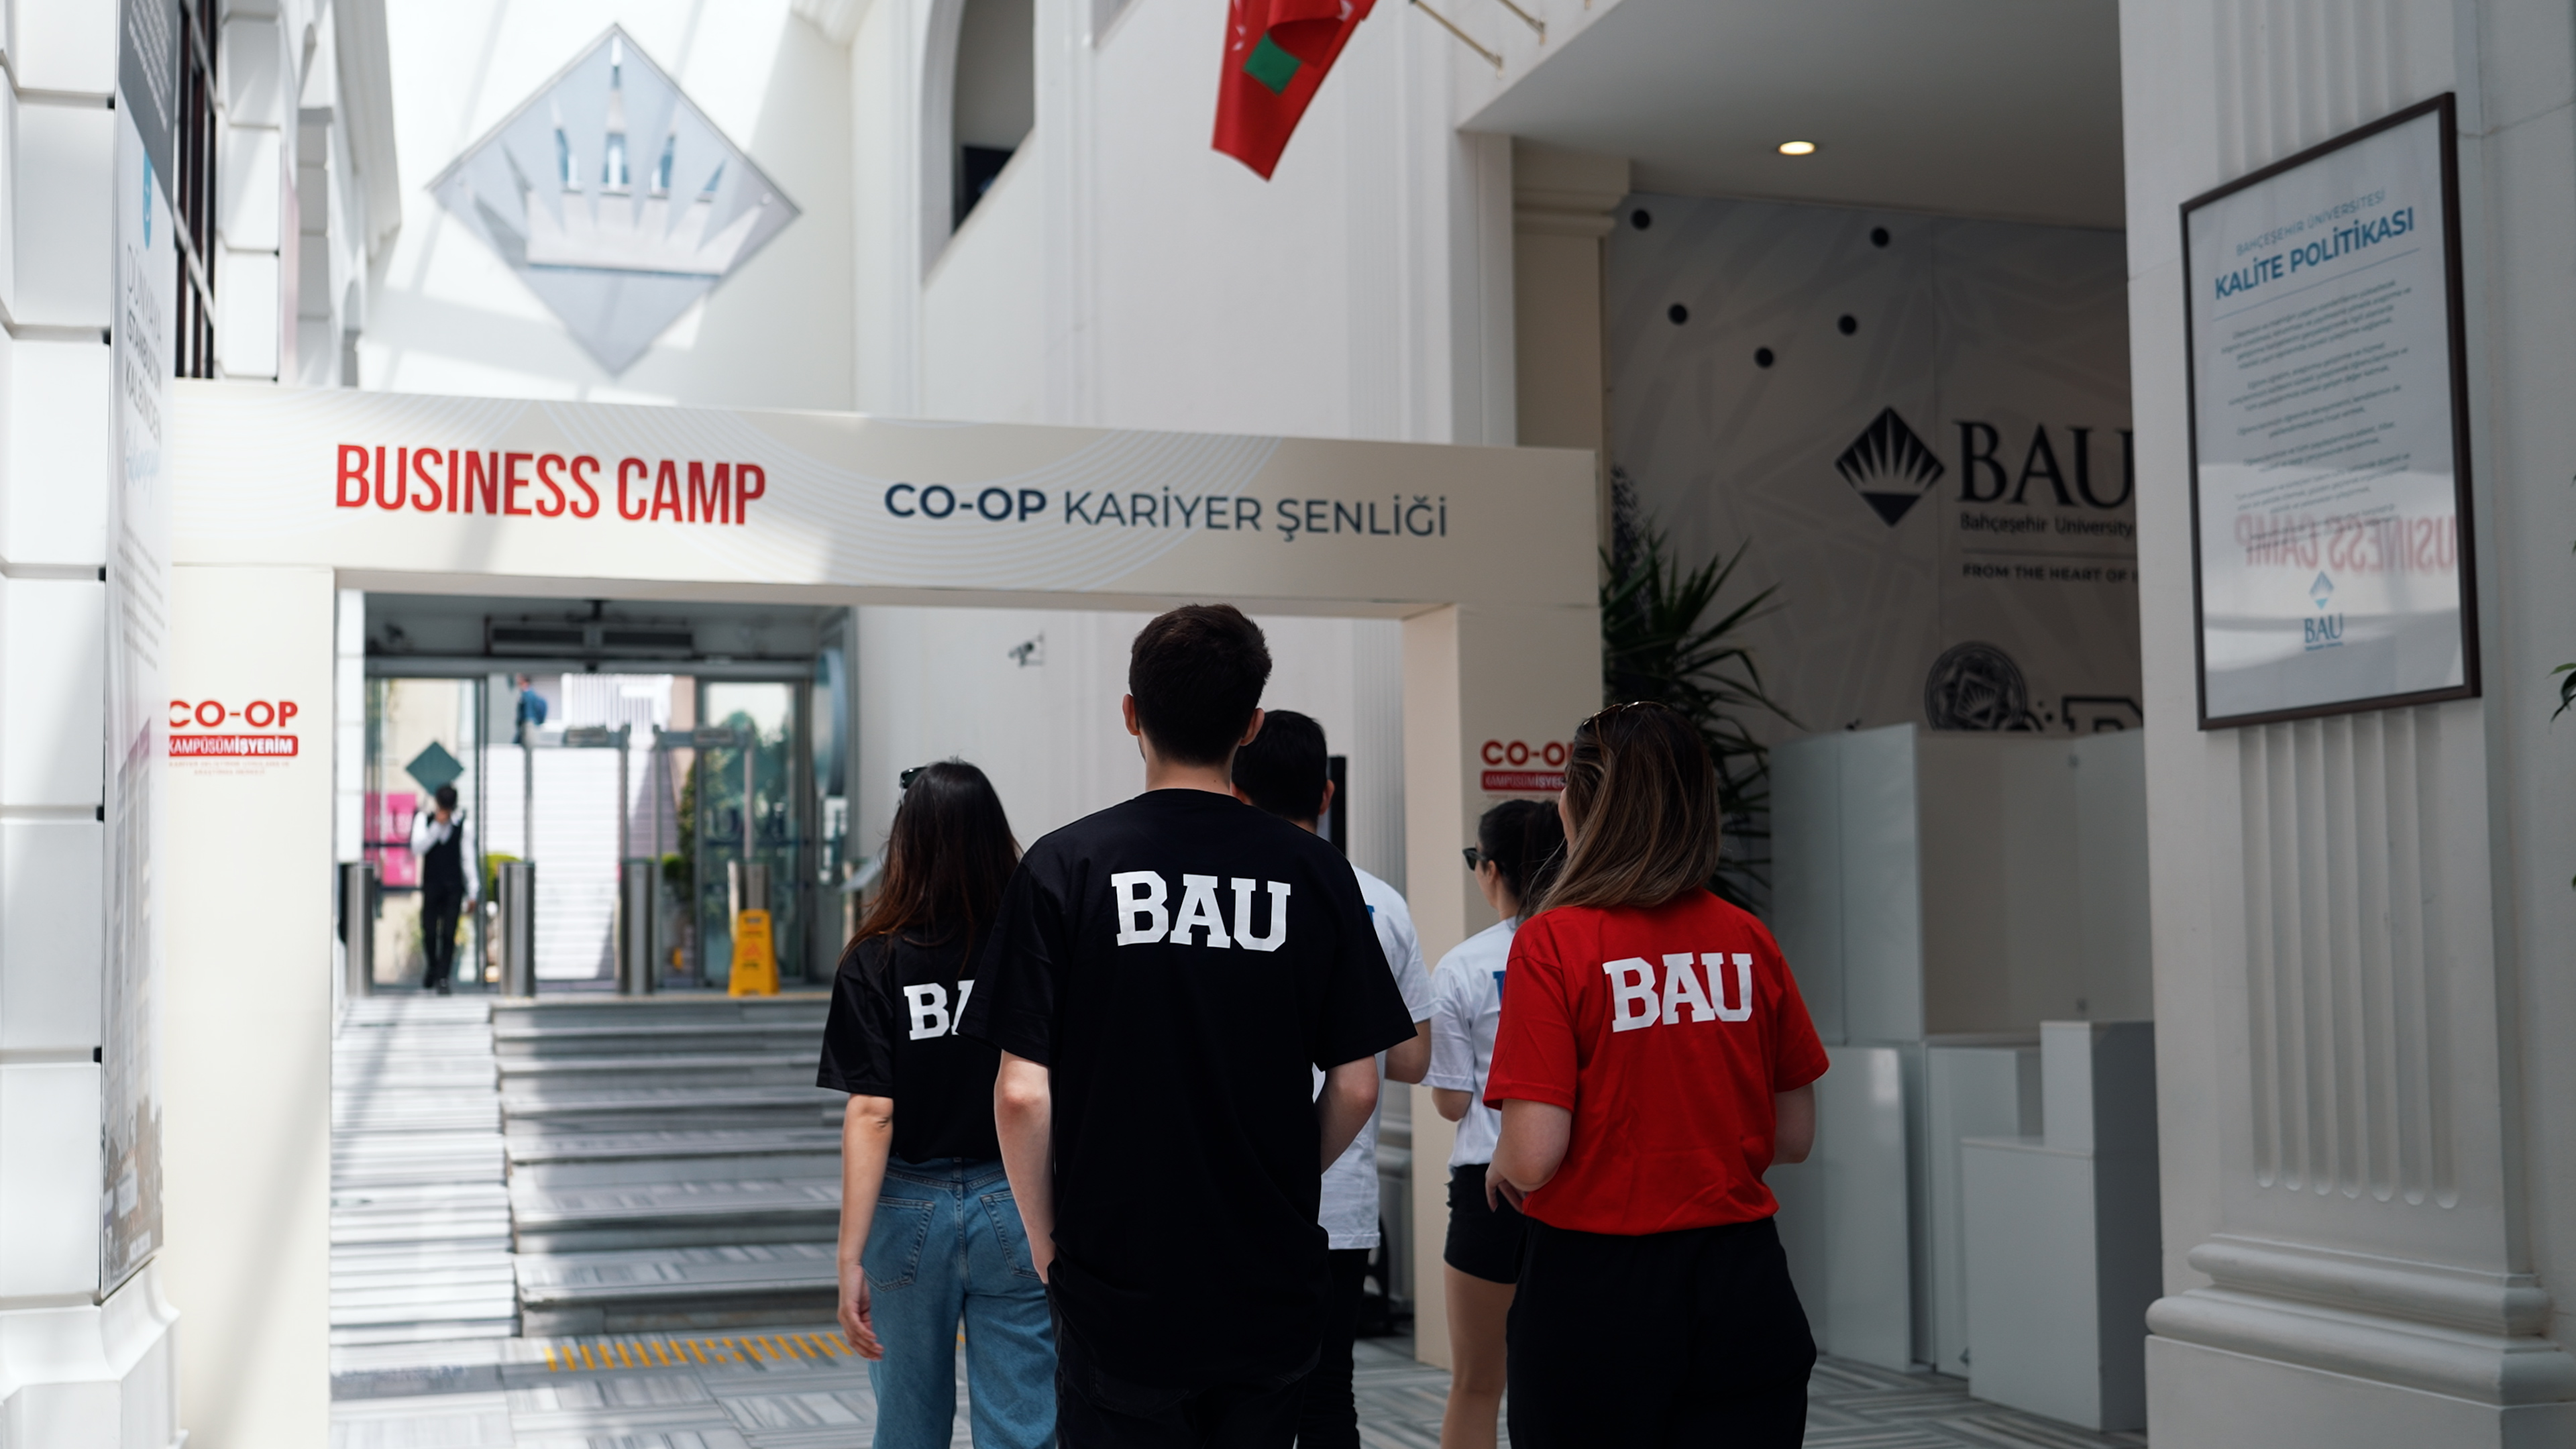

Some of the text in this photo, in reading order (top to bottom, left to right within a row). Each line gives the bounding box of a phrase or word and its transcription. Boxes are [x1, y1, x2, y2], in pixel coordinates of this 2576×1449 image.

[2215, 205, 2414, 300] KALİTE POLİTİKASI
[335, 443, 767, 526] BUSINESS CAMP
[1951, 419, 2133, 510] BAU
[884, 483, 1448, 542] CO-OP KARİYER ŞENLİĞİ
[1960, 513, 2135, 541] Bahçeşehir University
[1962, 563, 2009, 578] FROM
[2014, 565, 2045, 580] THE
[2049, 566, 2102, 582] HEART
[2105, 568, 2126, 583] OF
[2304, 613, 2344, 644] BAU
[169, 700, 299, 729] CO-OP
[1110, 870, 1291, 953] BAU
[1602, 952, 1754, 1033] BAU
